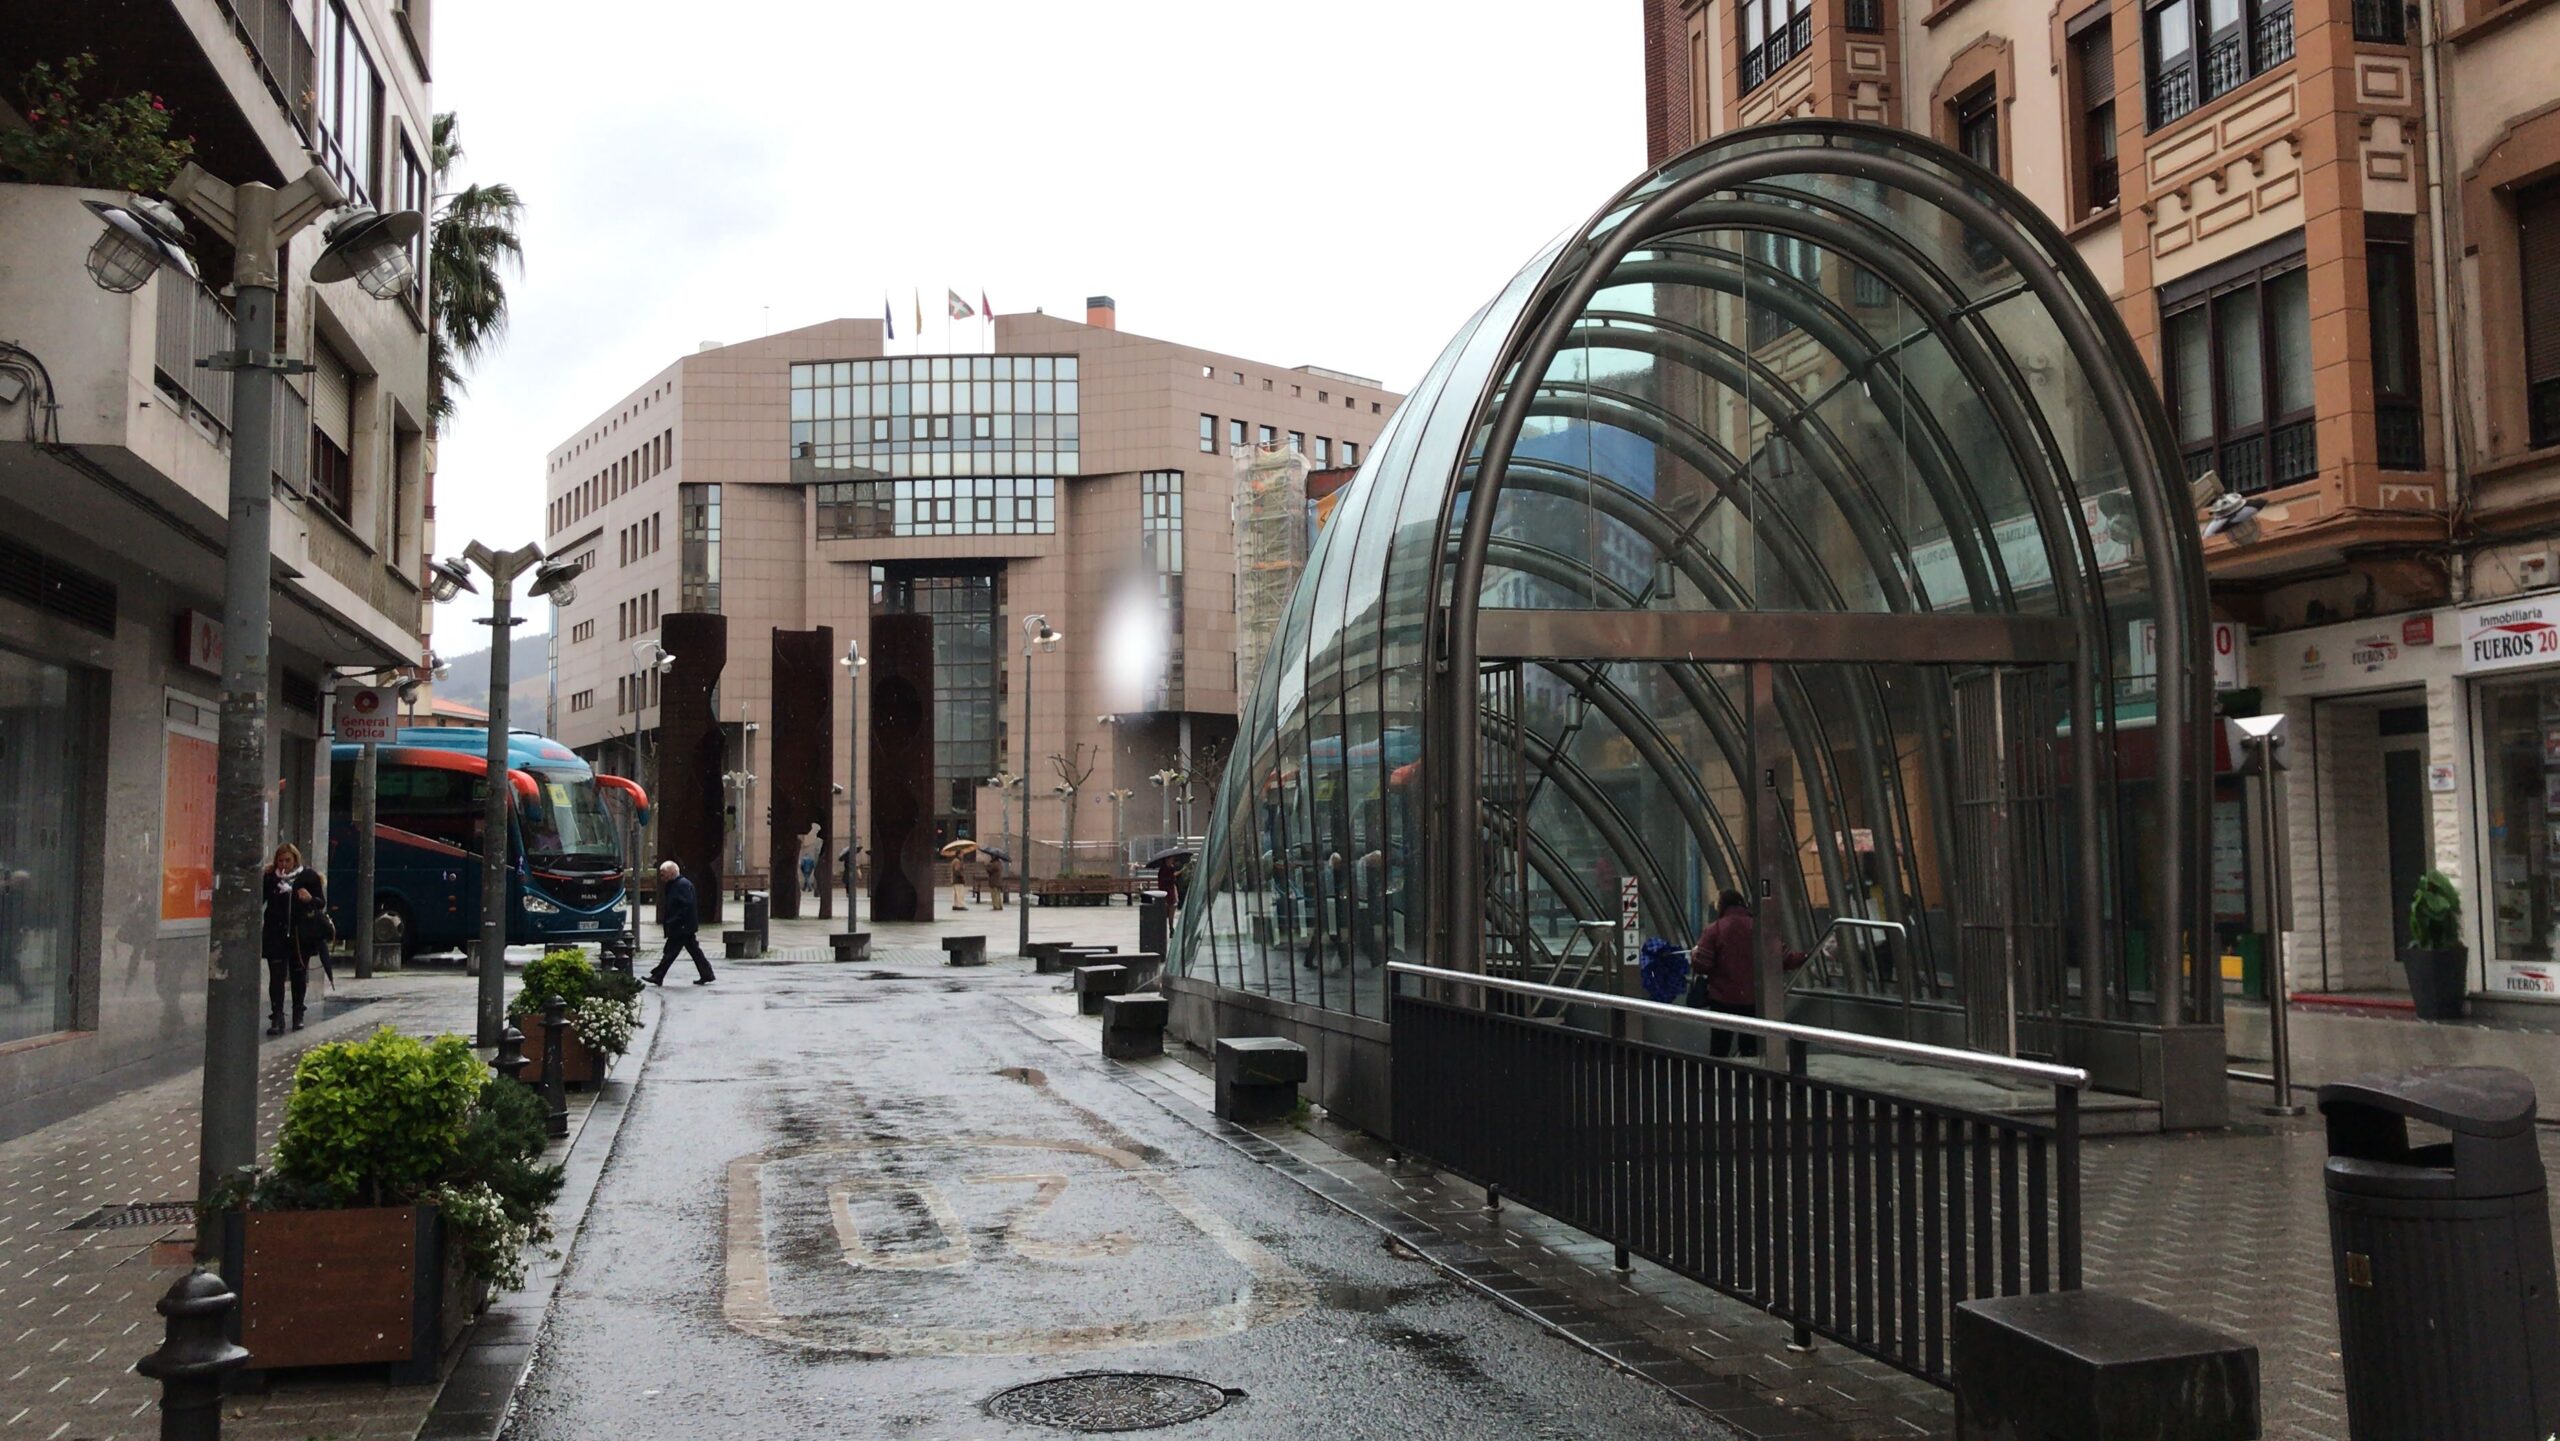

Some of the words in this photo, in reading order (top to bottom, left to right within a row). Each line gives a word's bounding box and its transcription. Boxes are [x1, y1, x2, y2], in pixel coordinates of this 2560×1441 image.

[2480, 608, 2543, 627] Inmobiliaria
[2474, 634, 2533, 661] FUEROS
[2539, 630, 2558, 652] 20
[2352, 650, 2384, 665] FUEROS
[342, 716, 389, 727] General
[345, 728, 384, 740] Optica
[2507, 977, 2541, 991] FUEROS
[2544, 980, 2555, 992] 20
